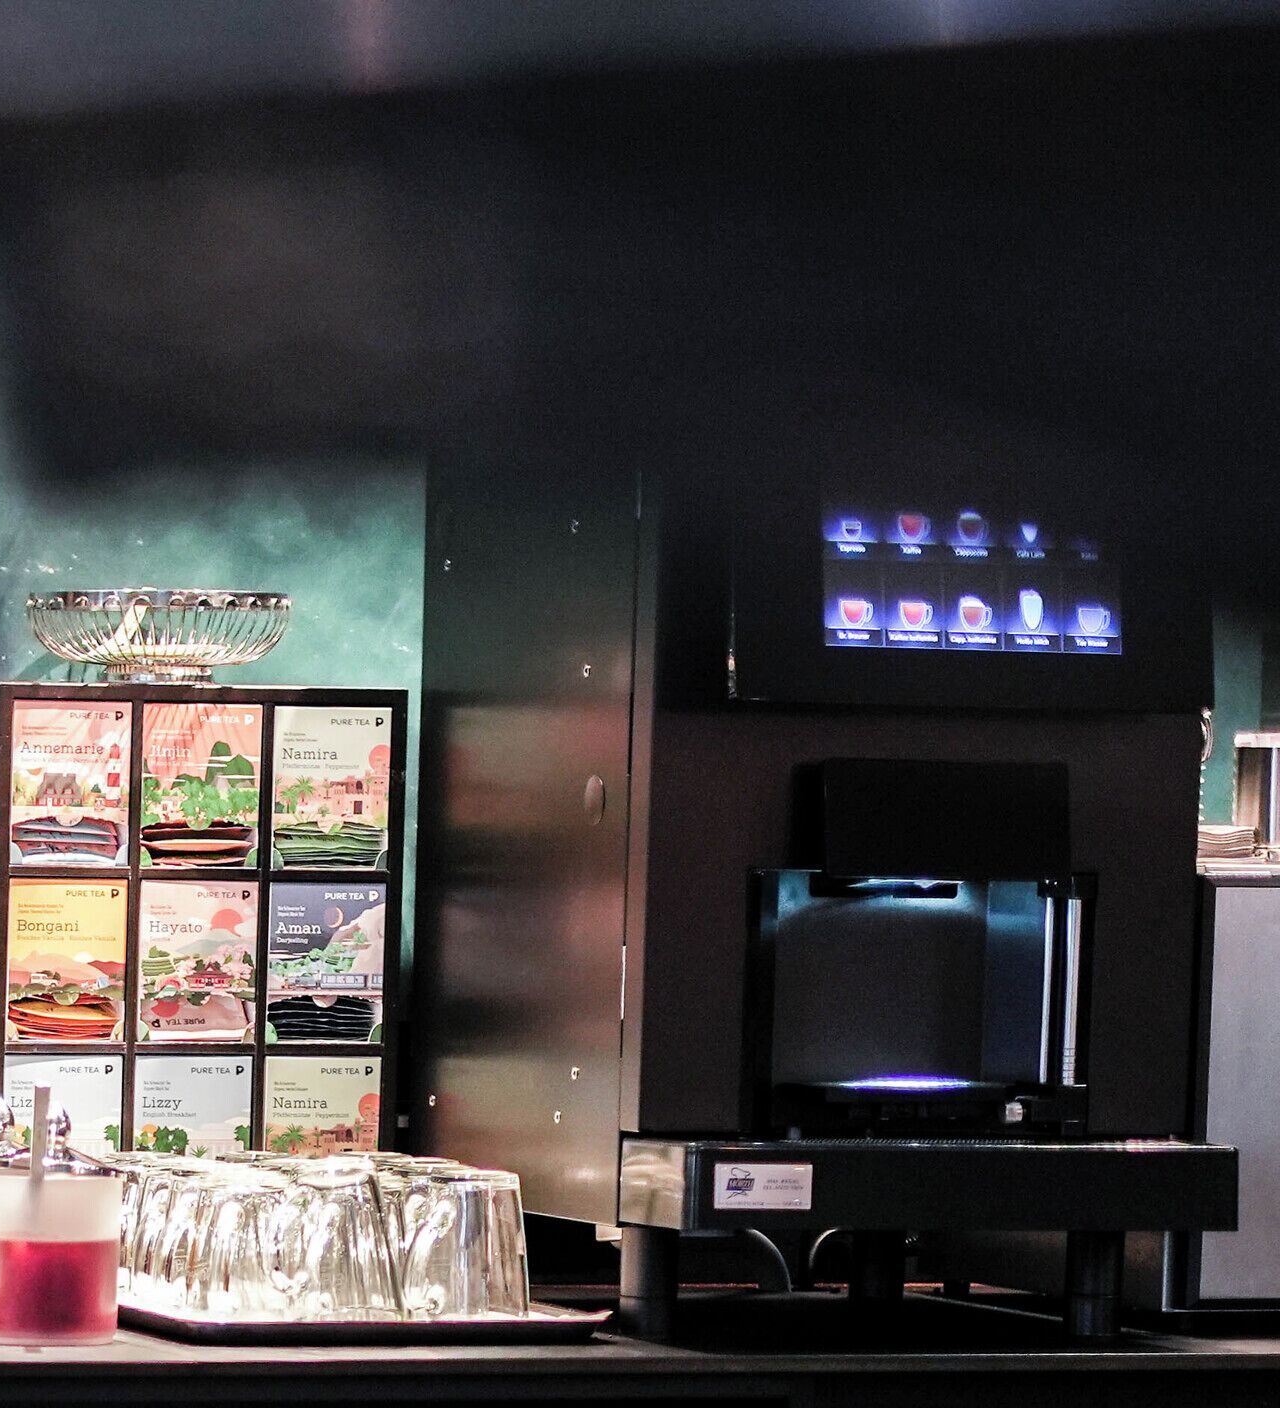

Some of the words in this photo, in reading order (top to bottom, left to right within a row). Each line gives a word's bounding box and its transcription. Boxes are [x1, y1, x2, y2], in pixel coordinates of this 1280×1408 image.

[69, 711, 92, 720] PURE
[94, 712, 110, 720] TEA
[331, 718, 352, 726] PURE
[355, 718, 371, 726] TEA
[20, 741, 106, 755] Annemarie
[282, 747, 338, 760] Namira
[65, 889, 88, 897] PURE
[91, 889, 106, 897] TEA
[197, 891, 219, 899] PURE
[222, 891, 237, 899] TEA
[324, 891, 348, 900] PURE
[349, 892, 365, 900] TEA
[17, 919, 80, 935] Bongani
[149, 920, 203, 935] Hayato
[275, 922, 322, 935] Aman
[60, 1066, 82, 1074] PURE
[84, 1066, 100, 1074] TEA
[191, 1067, 213, 1075] PURE
[216, 1067, 231, 1075] TEA
[321, 1067, 343, 1075] PURE
[345, 1067, 360, 1075] TEA
[11, 1096, 33, 1108] Liz
[142, 1096, 182, 1111] Lizzy
[273, 1096, 328, 1109] Namira
